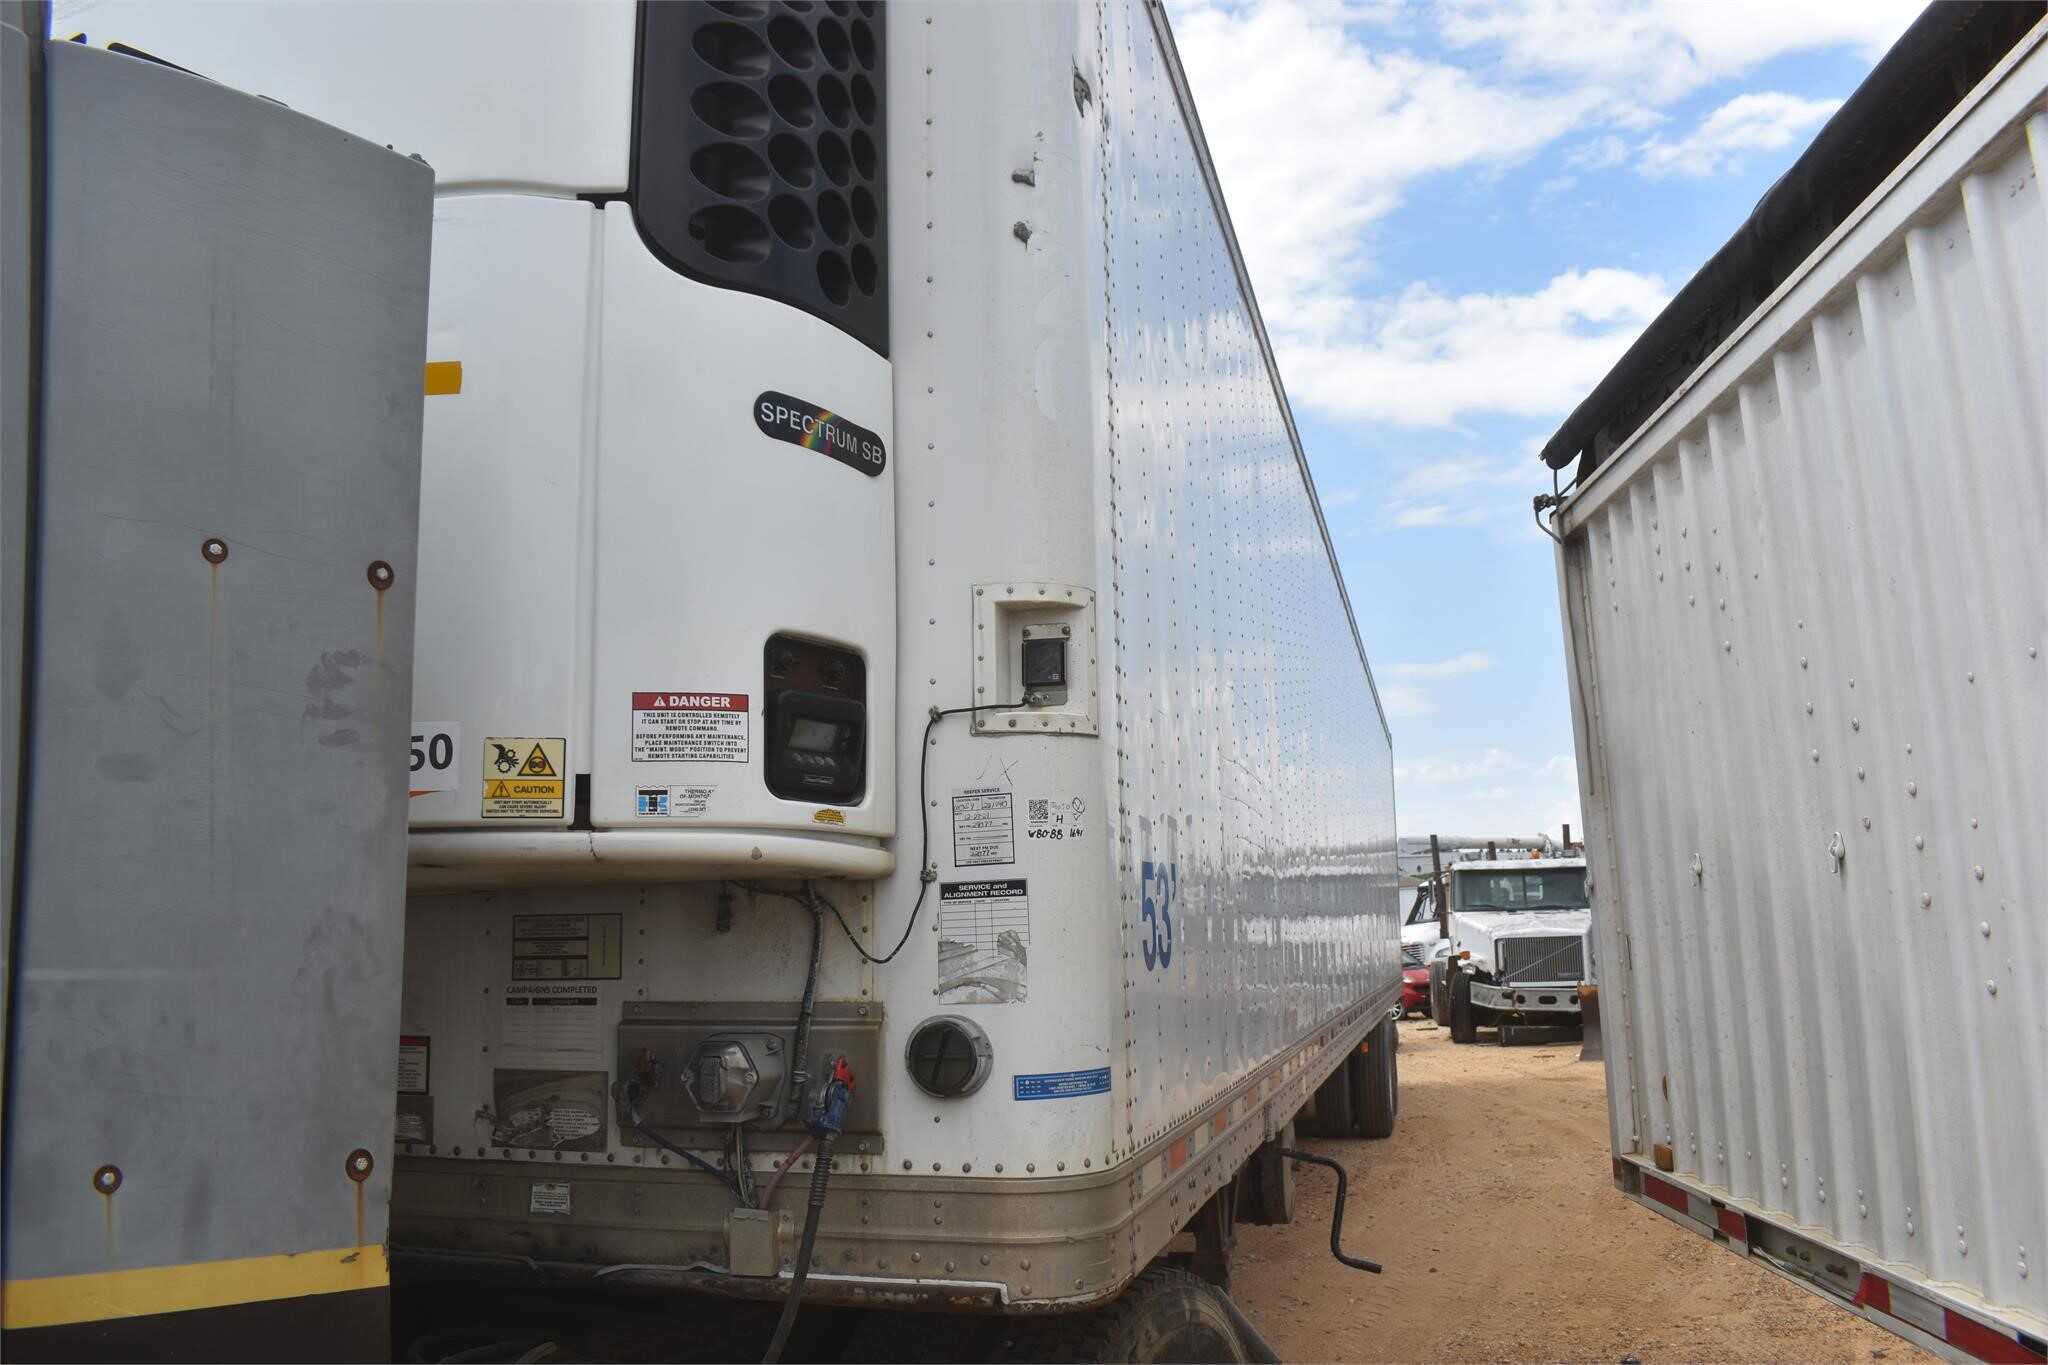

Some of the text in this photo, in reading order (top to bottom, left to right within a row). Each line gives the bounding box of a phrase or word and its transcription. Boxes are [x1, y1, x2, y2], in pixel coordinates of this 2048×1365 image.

[760, 402, 882, 464] SPECTRUM SB
[669, 696, 731, 708] DANGER
[513, 786, 555, 794] CAUTION
[1056, 814, 1064, 824] H
[506, 986, 598, 994] CAMPAIGNS COMPLETED
